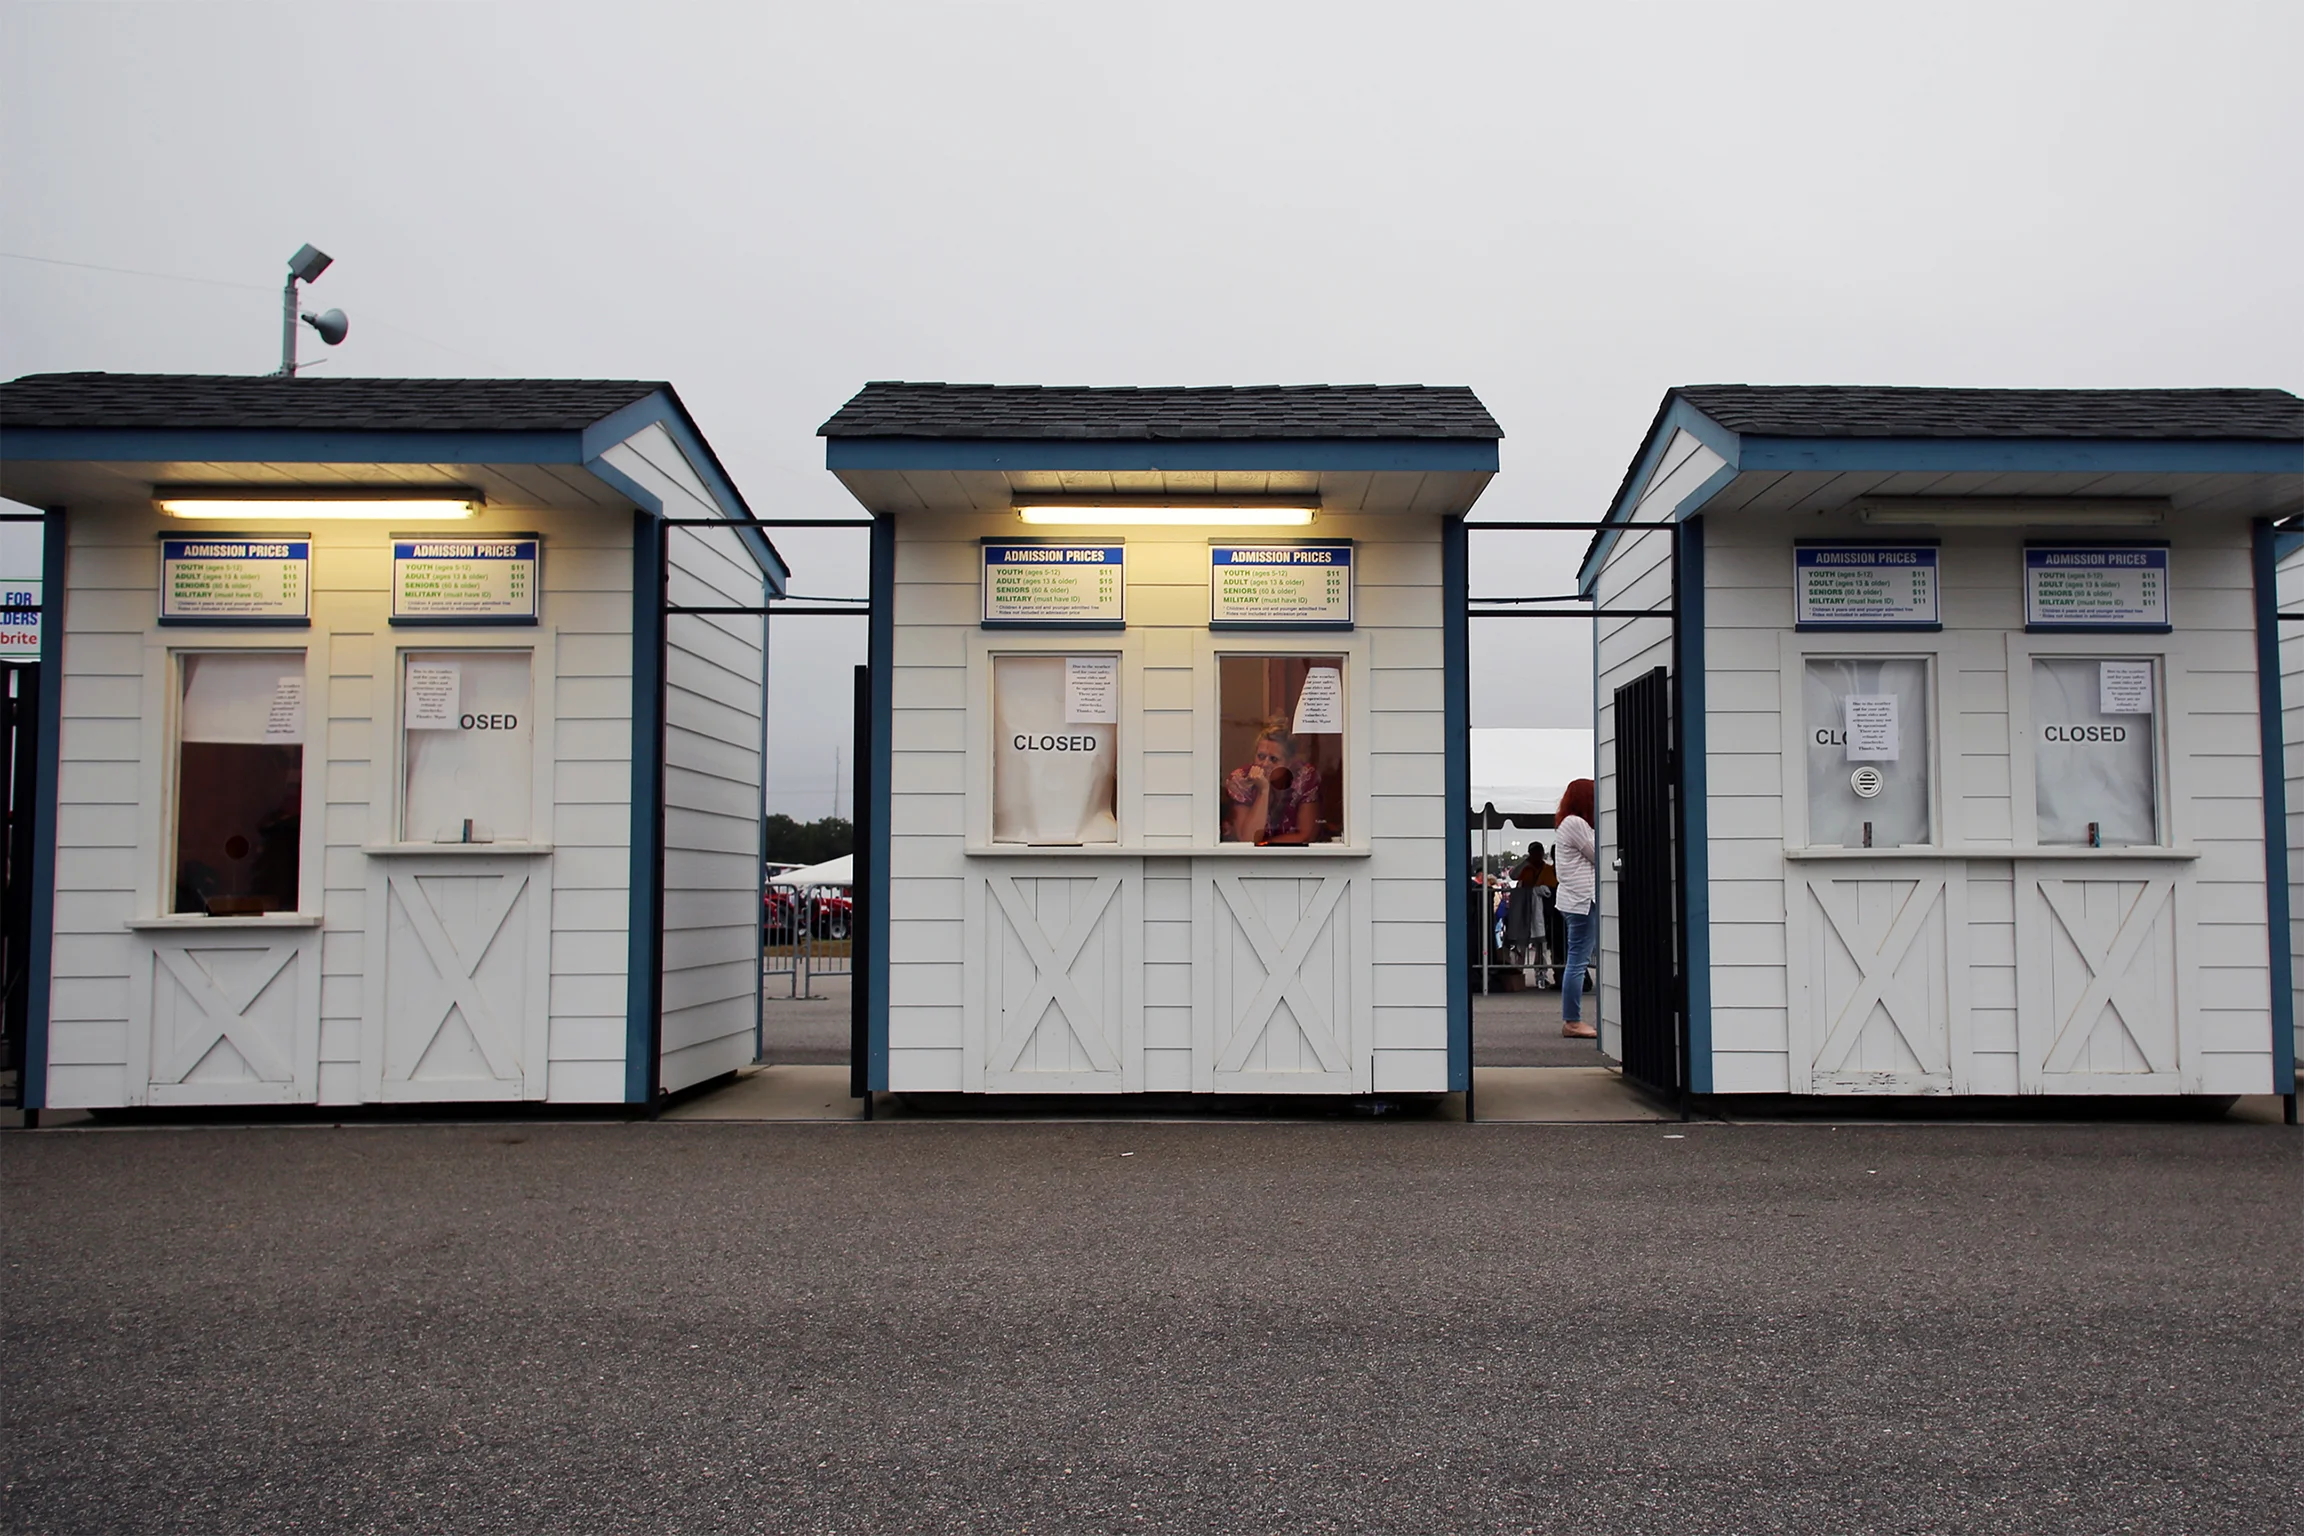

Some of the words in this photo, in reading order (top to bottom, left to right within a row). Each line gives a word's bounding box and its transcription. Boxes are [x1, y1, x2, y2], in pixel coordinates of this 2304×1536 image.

[184, 545, 246, 557] ADMISSION
[249, 545, 289, 557] PRICES
[413, 545, 474, 557] ADMISSION
[478, 545, 516, 557] PRICES
[1005, 550, 1063, 562] ADMISSION
[1066, 550, 1104, 562] PRICES
[1231, 551, 1290, 563] ADMISSION
[1294, 551, 1331, 563] PRICES
[1816, 553, 1875, 564] ADMISSION
[1879, 553, 1916, 564] PRICES
[2046, 554, 2105, 565] ADMISSION
[2109, 554, 2146, 565] PRICES
[6, 592, 32, 606] FOR
[0, 612, 37, 625] DERS
[460, 714, 517, 730] OSED
[2045, 726, 2125, 742] CLOSED
[1014, 735, 1096, 751] CLOSED
